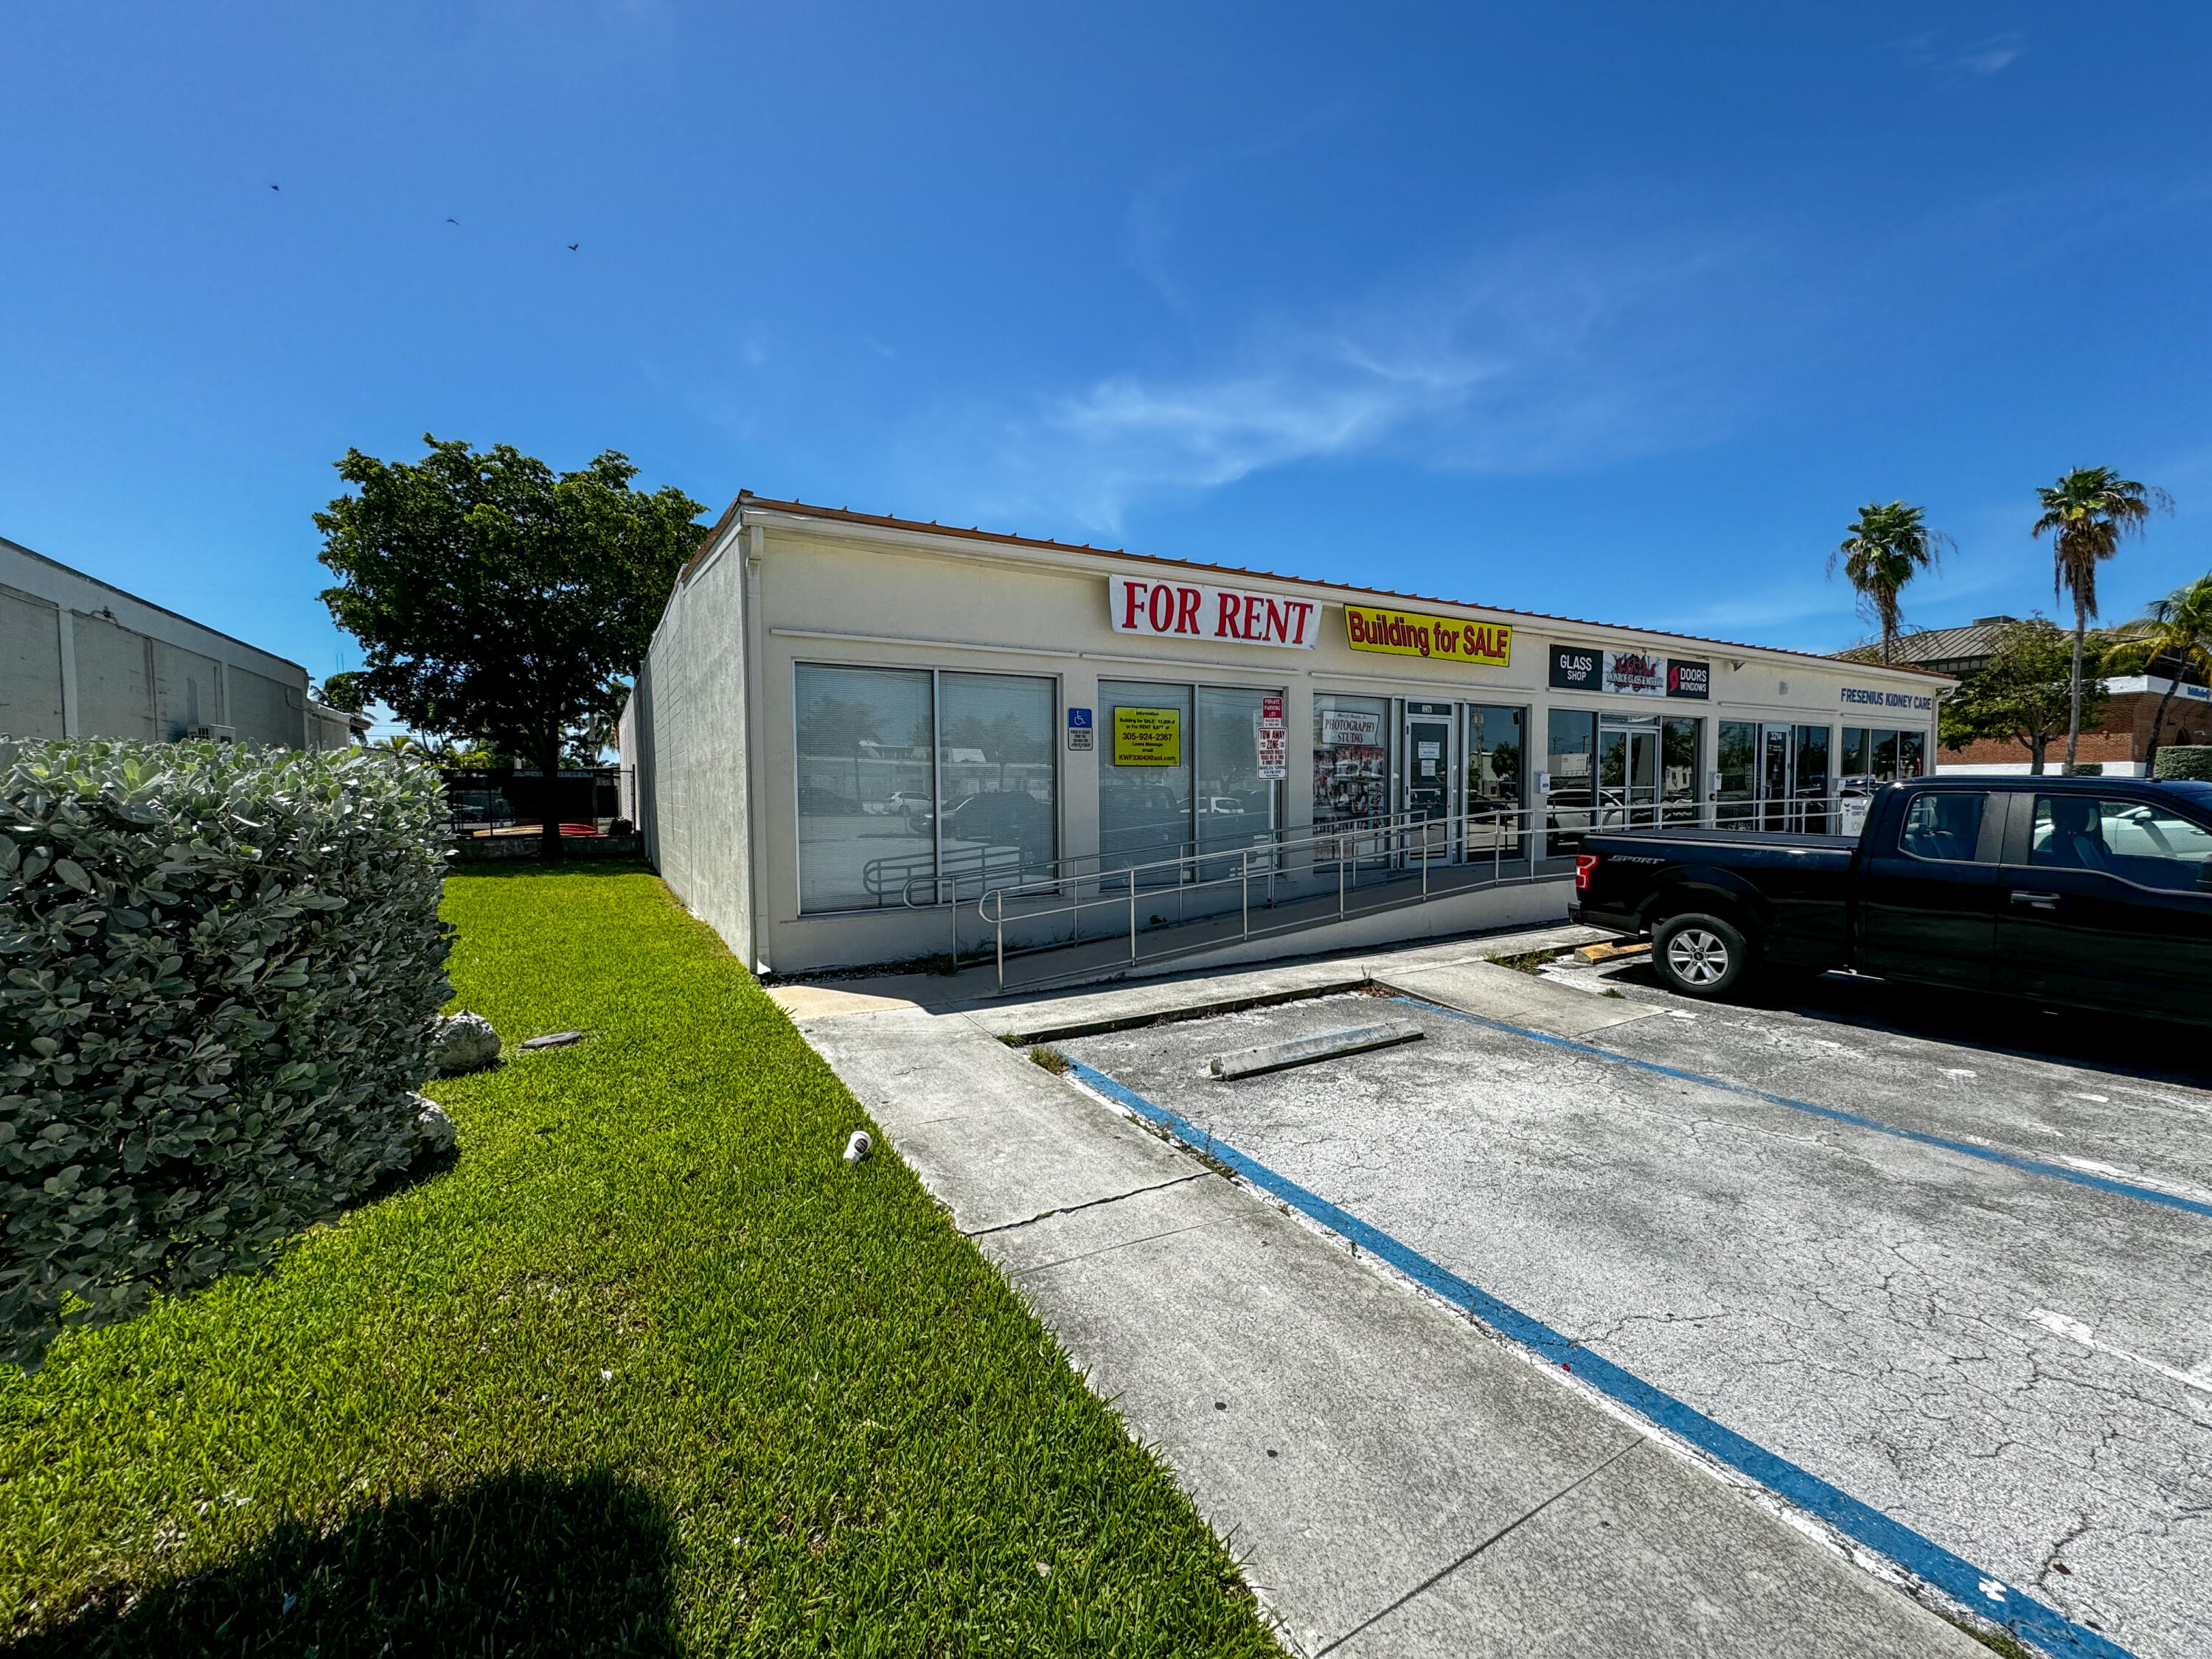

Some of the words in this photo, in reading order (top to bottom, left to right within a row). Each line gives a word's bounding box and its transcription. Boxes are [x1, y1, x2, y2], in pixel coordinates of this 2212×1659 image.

[1122, 581, 1201, 634] FOR
[1214, 593, 1313, 644] RENT
[1349, 611, 1430, 656] Building
[1433, 622, 1459, 653] for
[1463, 625, 1508, 658] SALE
[1560, 654, 1592, 672] GLASS
[1568, 670, 1587, 681] SHOP
[1606, 672, 1627, 684] MONROE
[1627, 675, 1641, 684] GLASS
[1642, 676, 1646, 685] &
[1680, 667, 1707, 683] DOORS
[1680, 681, 1707, 692] WINDOWS
[1840, 688, 1883, 706] FRESENIUS
[1885, 693, 1913, 708] KIDNEY
[1913, 697, 1931, 710] CARE
[1325, 719, 1376, 733] PHOTOGRAPHY
[1122, 732, 1172, 741] 305-924-2367
[1259, 730, 1270, 740] TOW
[1273, 730, 1285, 740] AWAY
[1338, 732, 1363, 743] STUDIO
[1770, 732, 1782, 741] 3214
[1267, 740, 1279, 749] ZONE
[1607, 855, 1666, 865] SPORT
